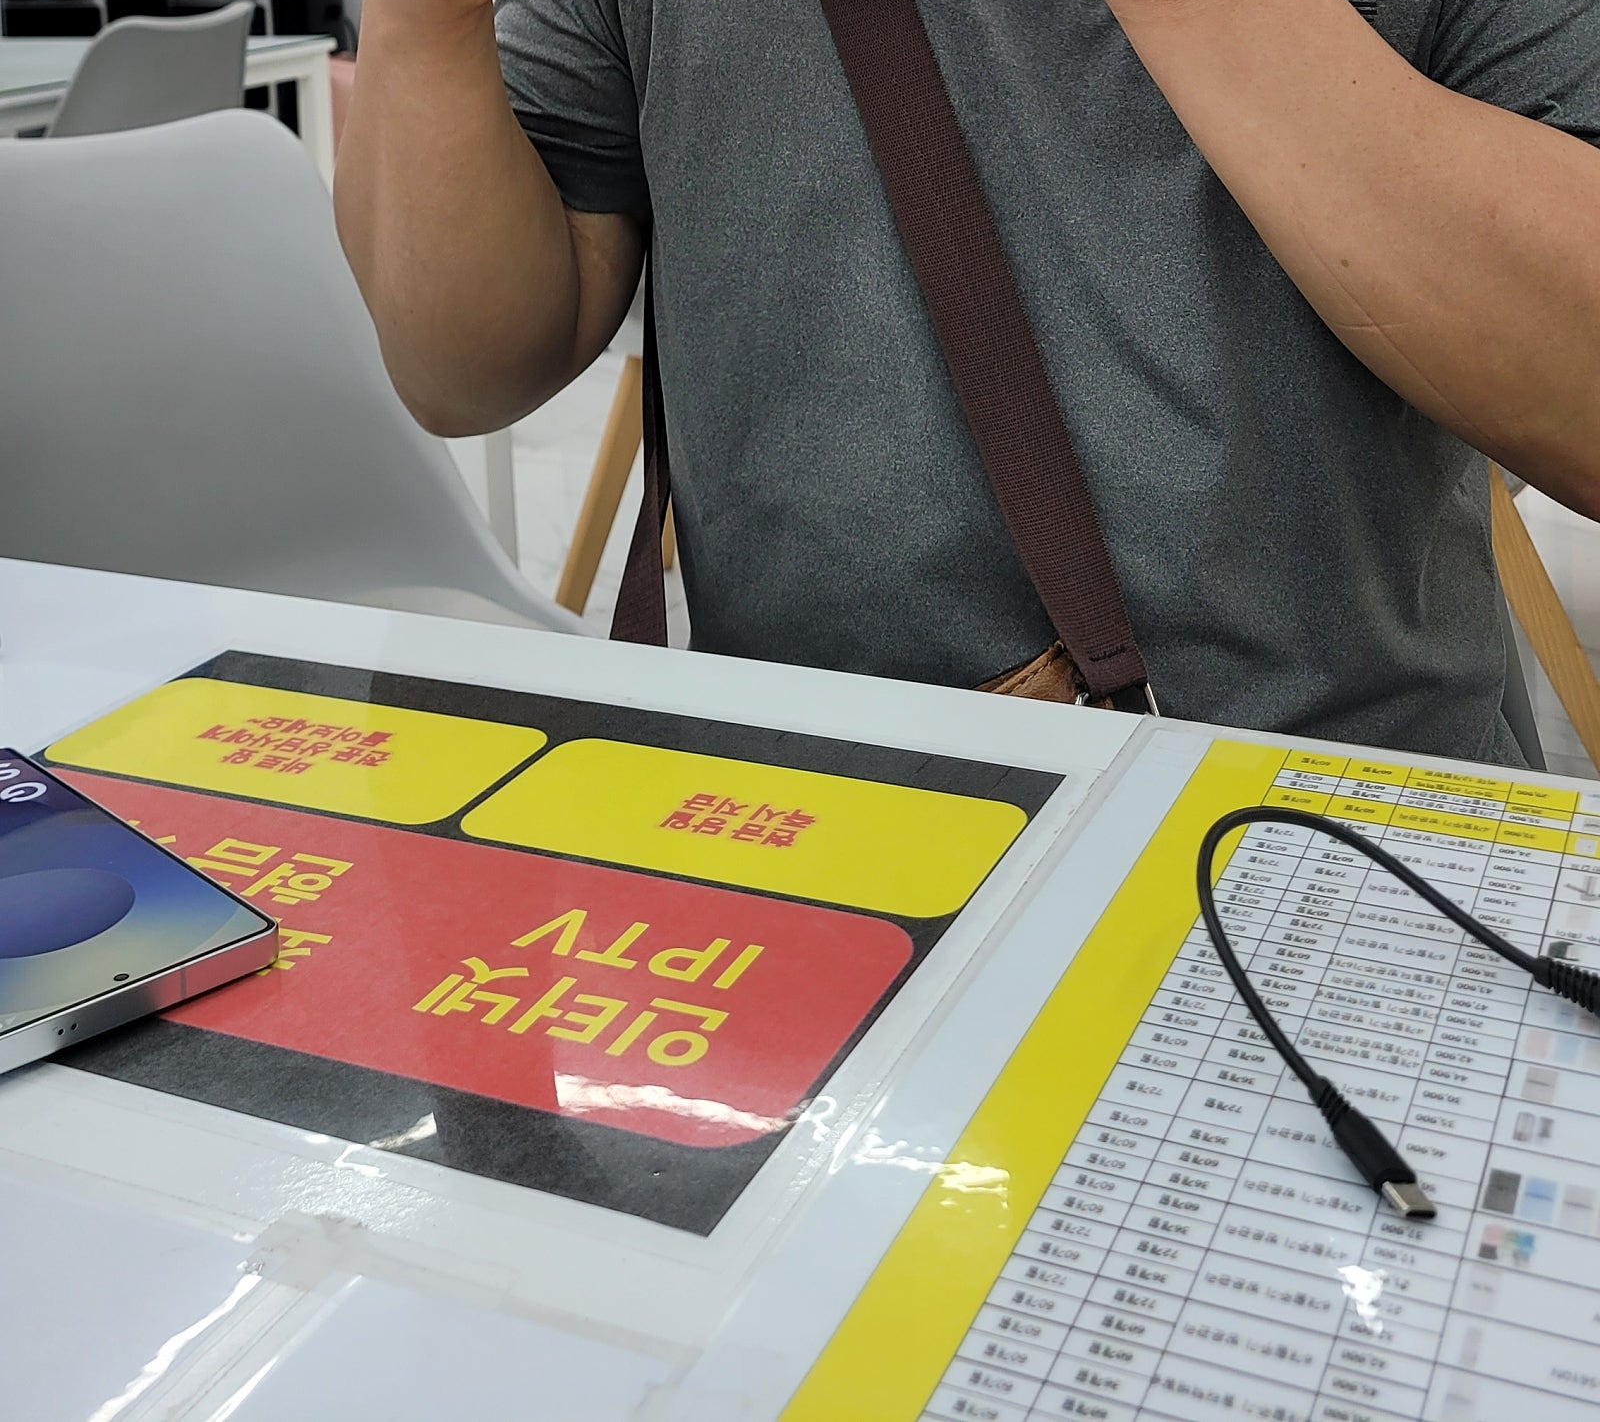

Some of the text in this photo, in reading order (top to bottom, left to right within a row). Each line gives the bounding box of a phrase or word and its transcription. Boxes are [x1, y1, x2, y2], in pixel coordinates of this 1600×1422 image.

[196, 724, 390, 767] 전문 상담사에게
[253, 755, 312, 774] 바로
[682, 794, 816, 828] 즉시 지급
[659, 811, 798, 848] 현금 당일
[1339, 821, 1368, 831] 36개
[1222, 922, 1246, 932] 60개
[510, 909, 765, 989] IPTV
[411, 957, 730, 1067] 인터넷
[1261, 996, 1289, 1008] 60개
[1237, 1028, 1270, 1041] 0개월
